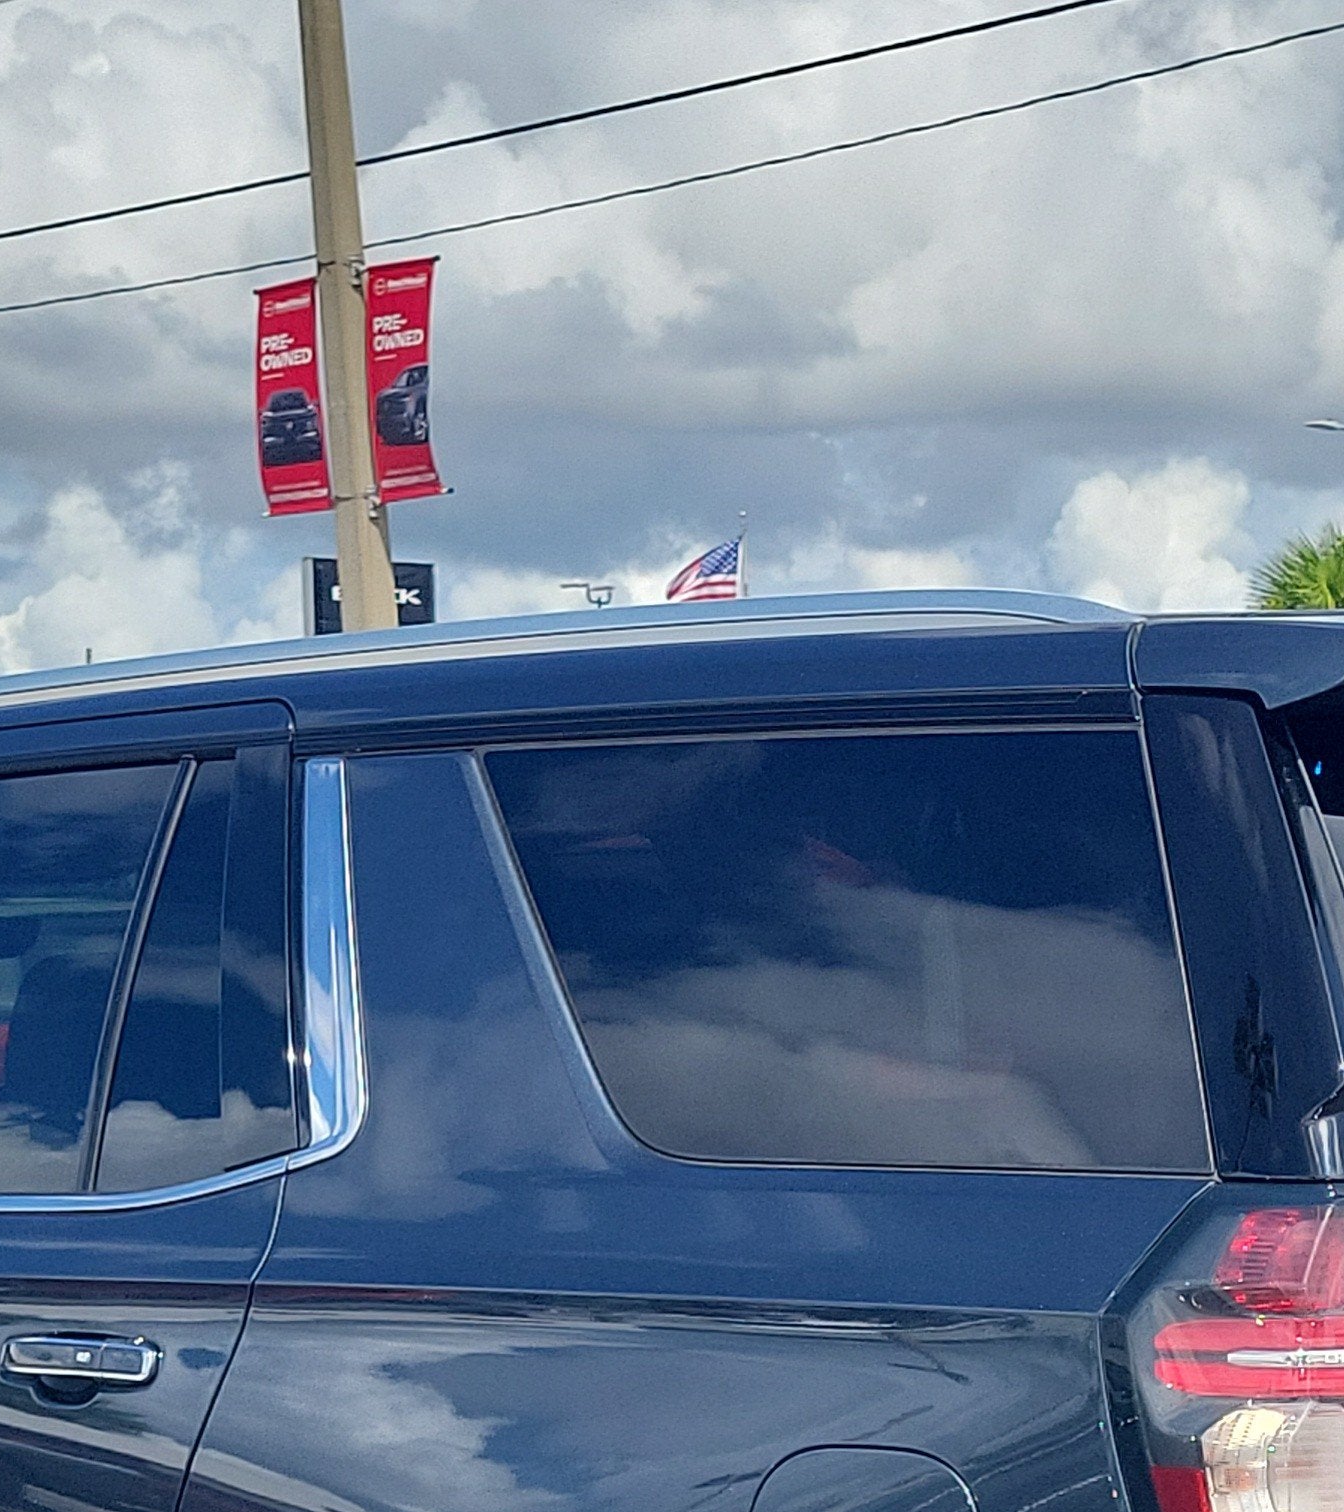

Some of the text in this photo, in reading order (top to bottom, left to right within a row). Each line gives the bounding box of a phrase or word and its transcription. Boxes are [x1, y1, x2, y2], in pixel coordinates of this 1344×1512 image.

[373, 313, 408, 334] PRE-
[260, 333, 295, 354] PRE-
[373, 328, 424, 352] OWNED
[260, 347, 313, 372] OWNED
